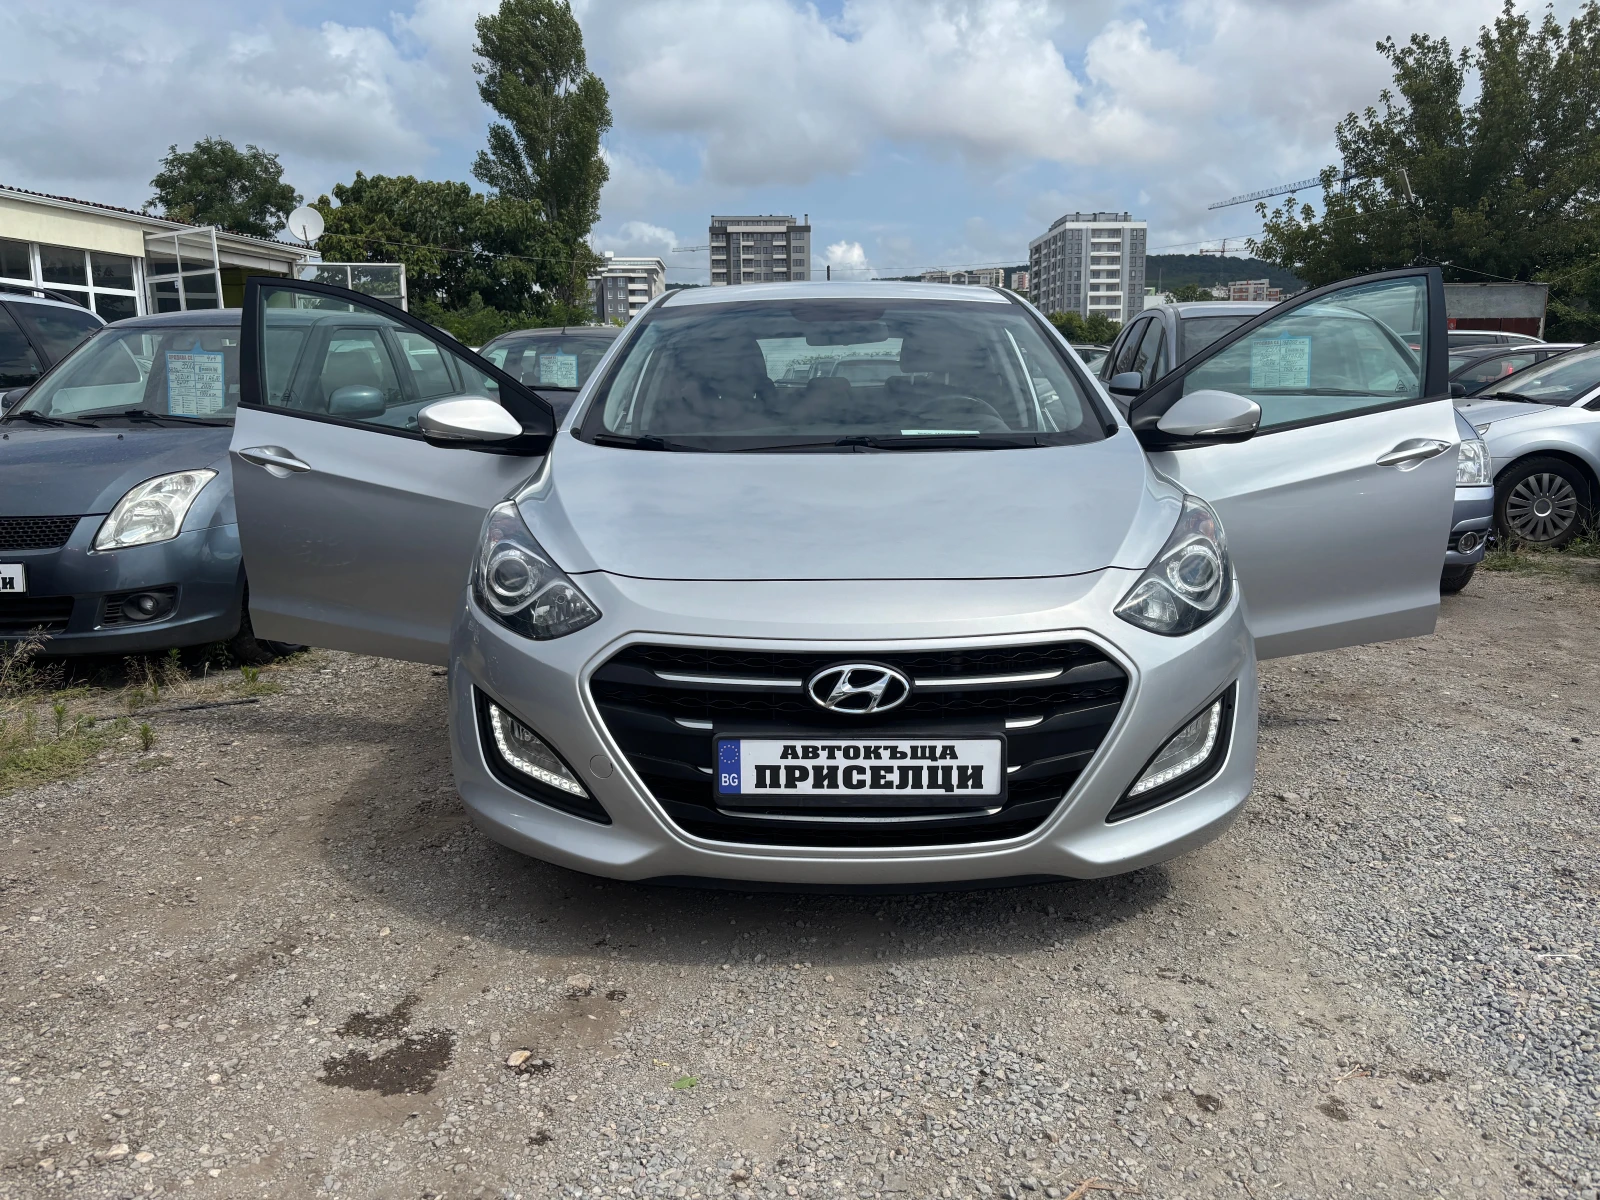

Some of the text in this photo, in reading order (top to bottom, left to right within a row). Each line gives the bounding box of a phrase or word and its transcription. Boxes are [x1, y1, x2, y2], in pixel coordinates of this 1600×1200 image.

[779, 744, 959, 762] АВТОКЪЩА
[721, 773, 739, 786] BG
[754, 764, 984, 792] ПРИСЕЛЦИ
